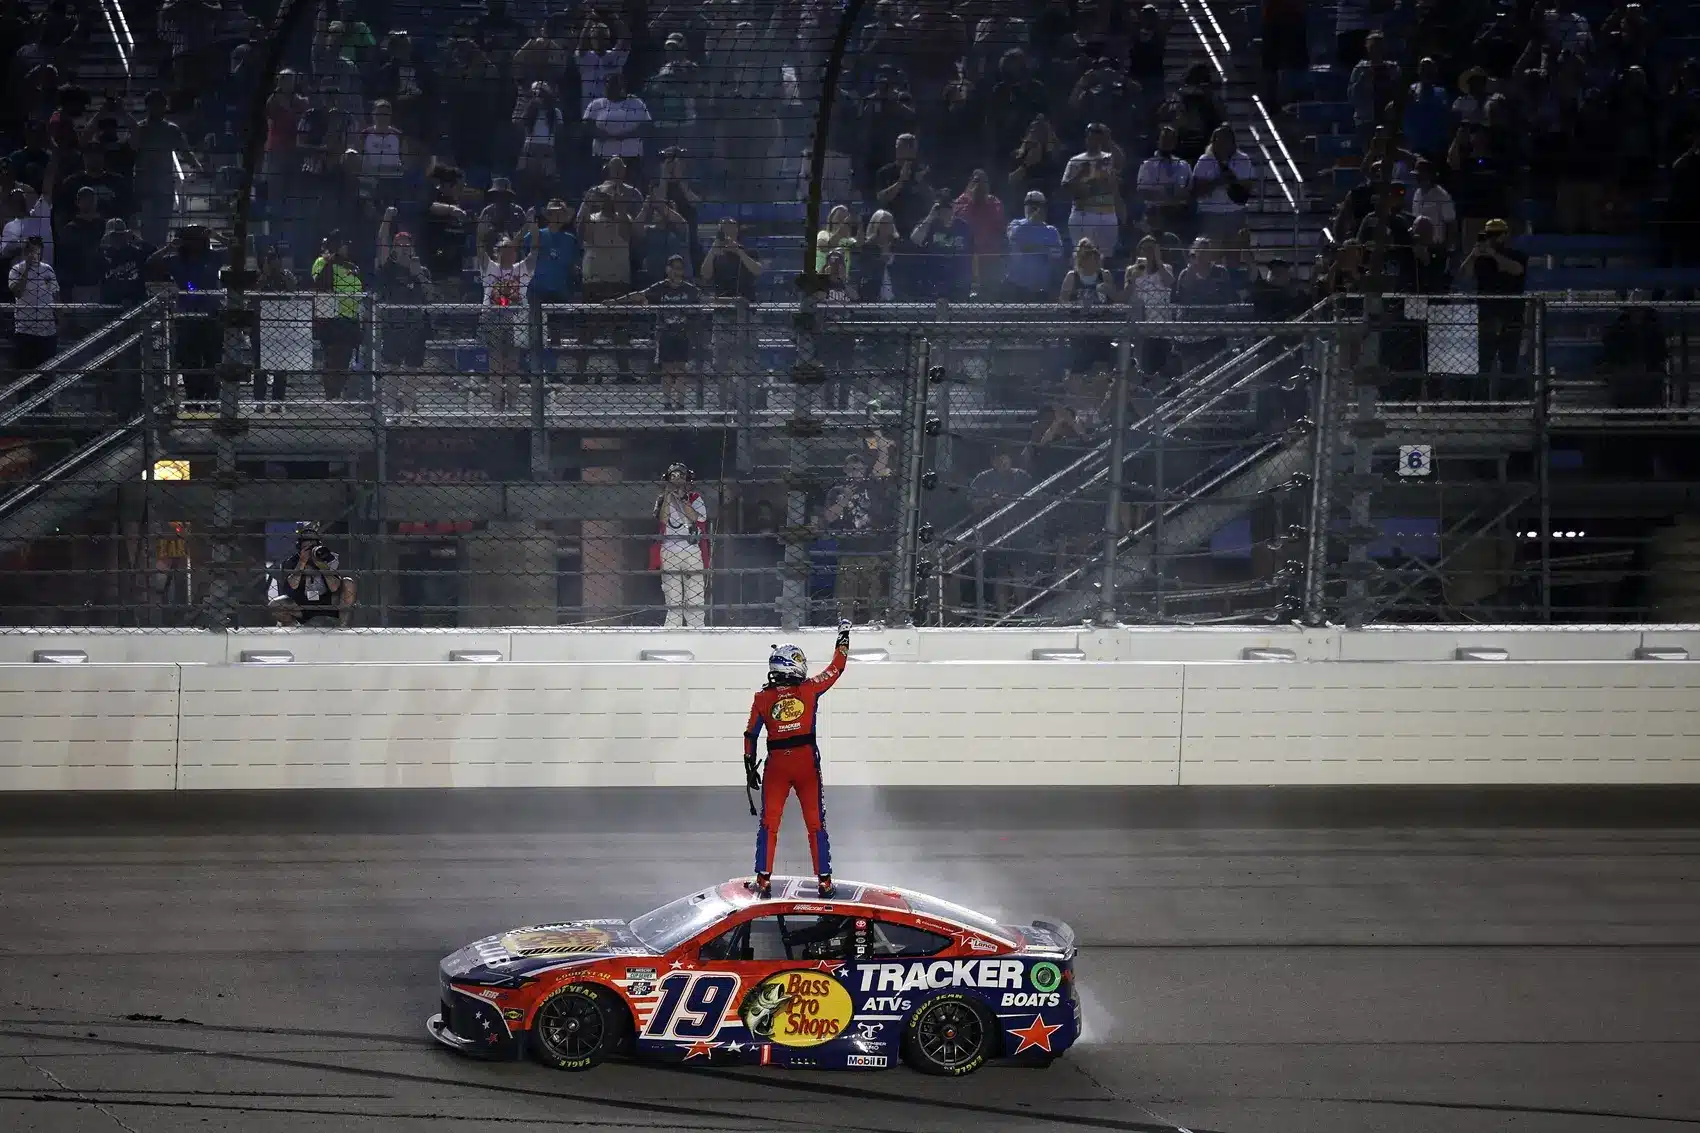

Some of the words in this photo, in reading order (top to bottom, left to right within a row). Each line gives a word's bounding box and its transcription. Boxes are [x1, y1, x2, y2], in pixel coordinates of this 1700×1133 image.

[1407, 450, 1423, 469] 6
[974, 939, 996, 950] Lance
[785, 973, 831, 997] Bass
[857, 960, 1025, 992] TRACKER
[479, 989, 500, 999] JGR
[862, 996, 912, 1011] ATVs
[1001, 993, 1061, 1007] BOATS
[644, 971, 740, 1040] 19
[785, 994, 820, 1016] Pro
[784, 1012, 840, 1040] Shops
[559, 1057, 591, 1068] EAGLE
[848, 1056, 875, 1065] Mobil
[954, 1055, 983, 1076] EAGLE
